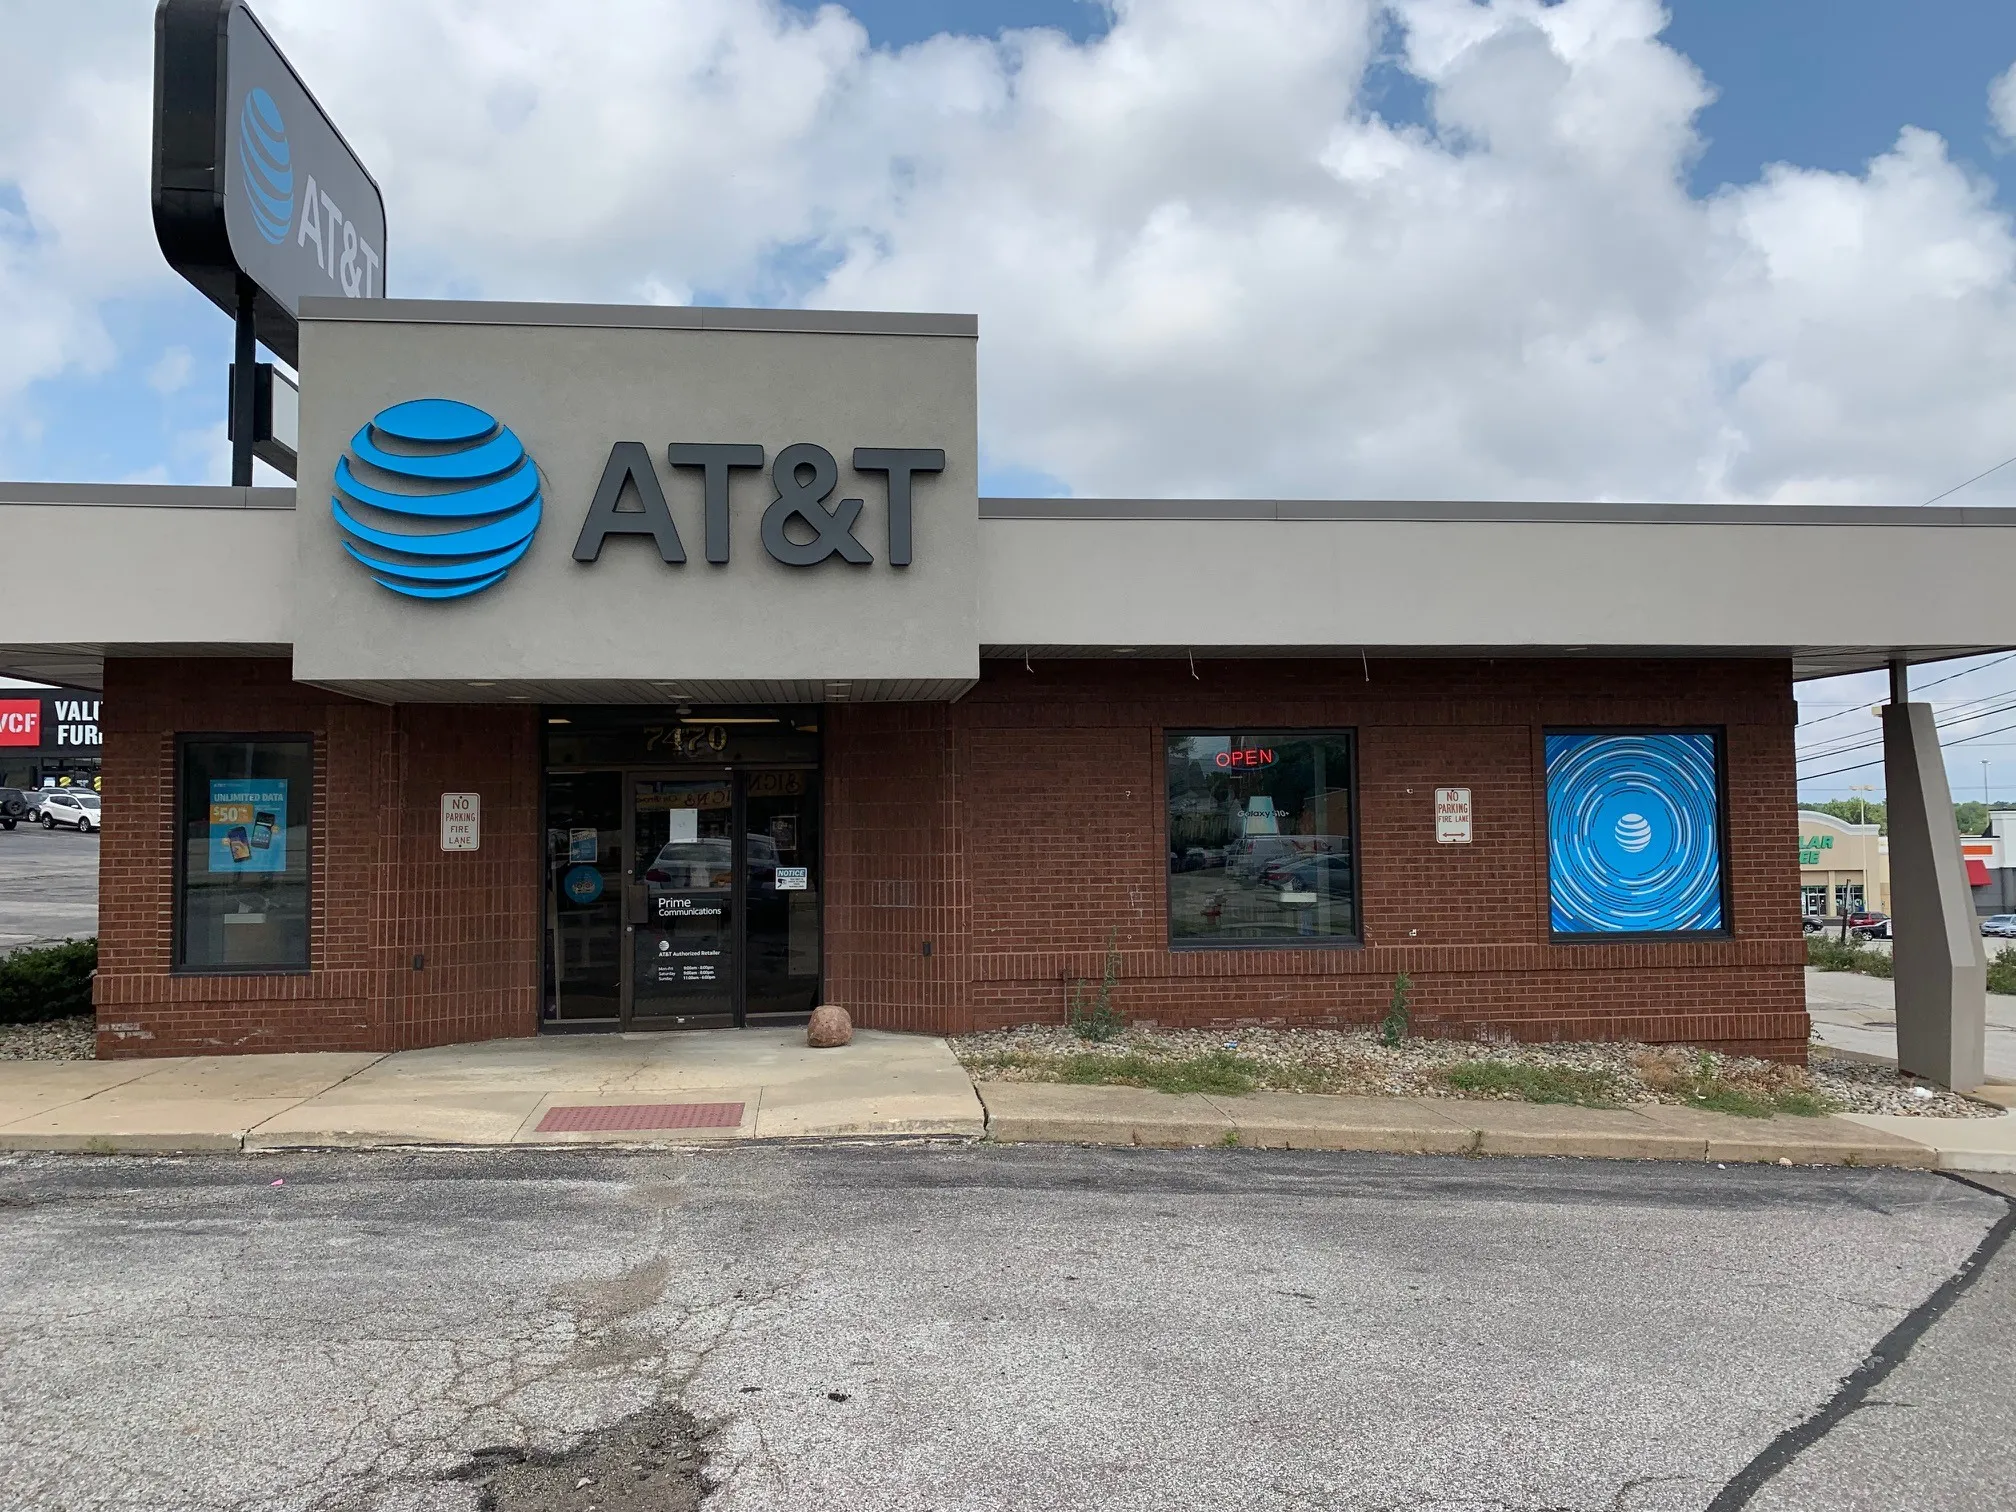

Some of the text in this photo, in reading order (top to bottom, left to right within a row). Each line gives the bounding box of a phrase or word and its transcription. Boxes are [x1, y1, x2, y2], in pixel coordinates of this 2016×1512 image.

[298, 174, 379, 298] AT&T
[572, 441, 946, 567] AT&T
[57, 724, 103, 745] FUR
[643, 725, 727, 751] 7470
[1216, 749, 1272, 767] OPEN
[213, 793, 284, 802] UNLIMITED DATA
[1446, 791, 1459, 801] NO
[452, 799, 469, 810] NO
[1438, 803, 1468, 813] PARKING
[213, 806, 239, 822] $50
[445, 812, 476, 822] PARKING
[1237, 810, 1270, 818] Galaxy
[450, 825, 469, 833] FIRE
[658, 897, 691, 908] Prime
[658, 907, 722, 917] Communications
